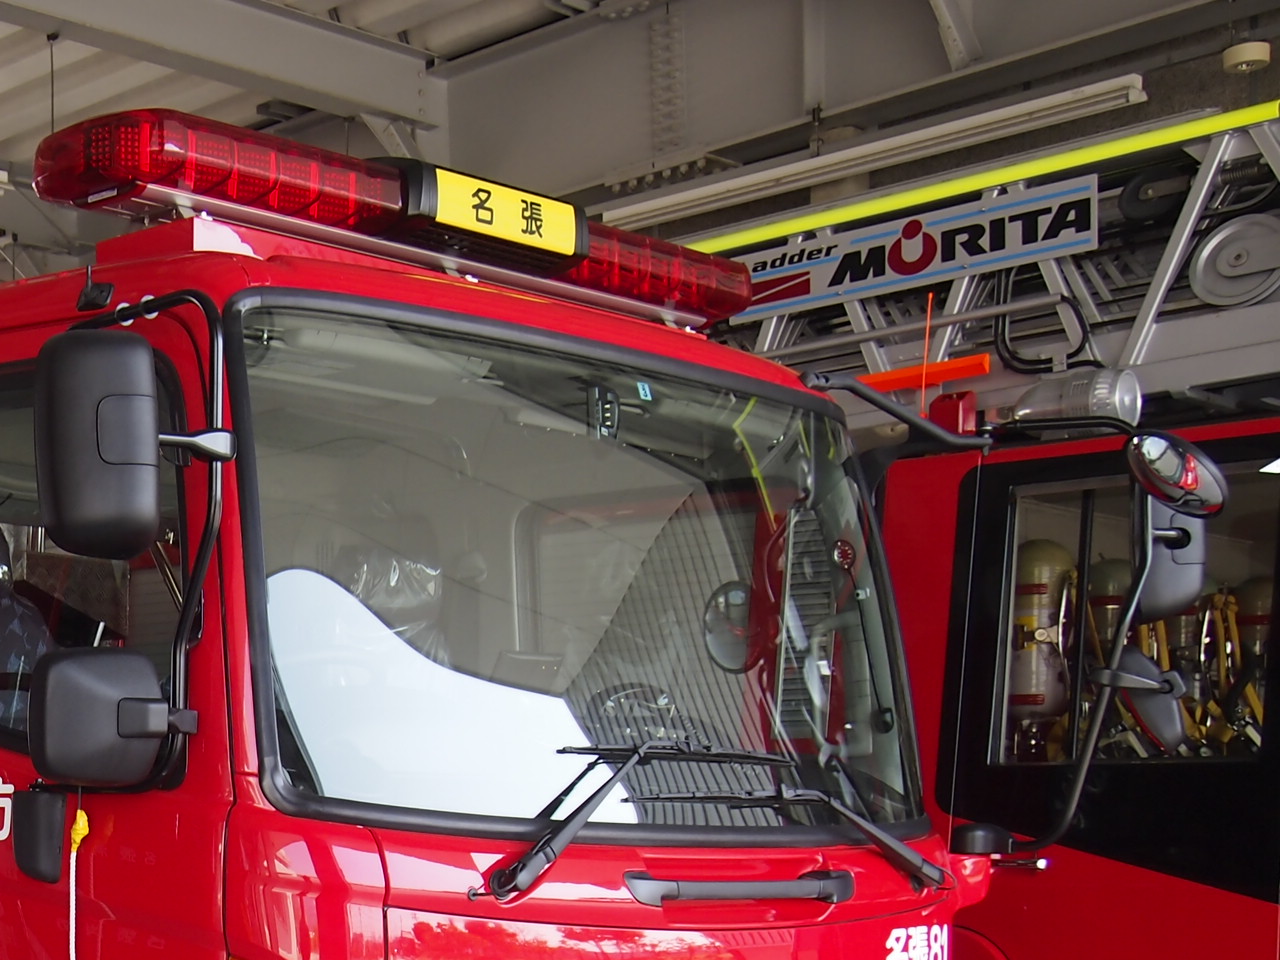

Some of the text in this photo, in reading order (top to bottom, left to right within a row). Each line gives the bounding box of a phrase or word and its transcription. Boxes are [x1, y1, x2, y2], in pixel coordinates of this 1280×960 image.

[472, 187, 544, 238] 名張
[751, 244, 838, 274] adder
[828, 198, 1092, 288] MORITA
